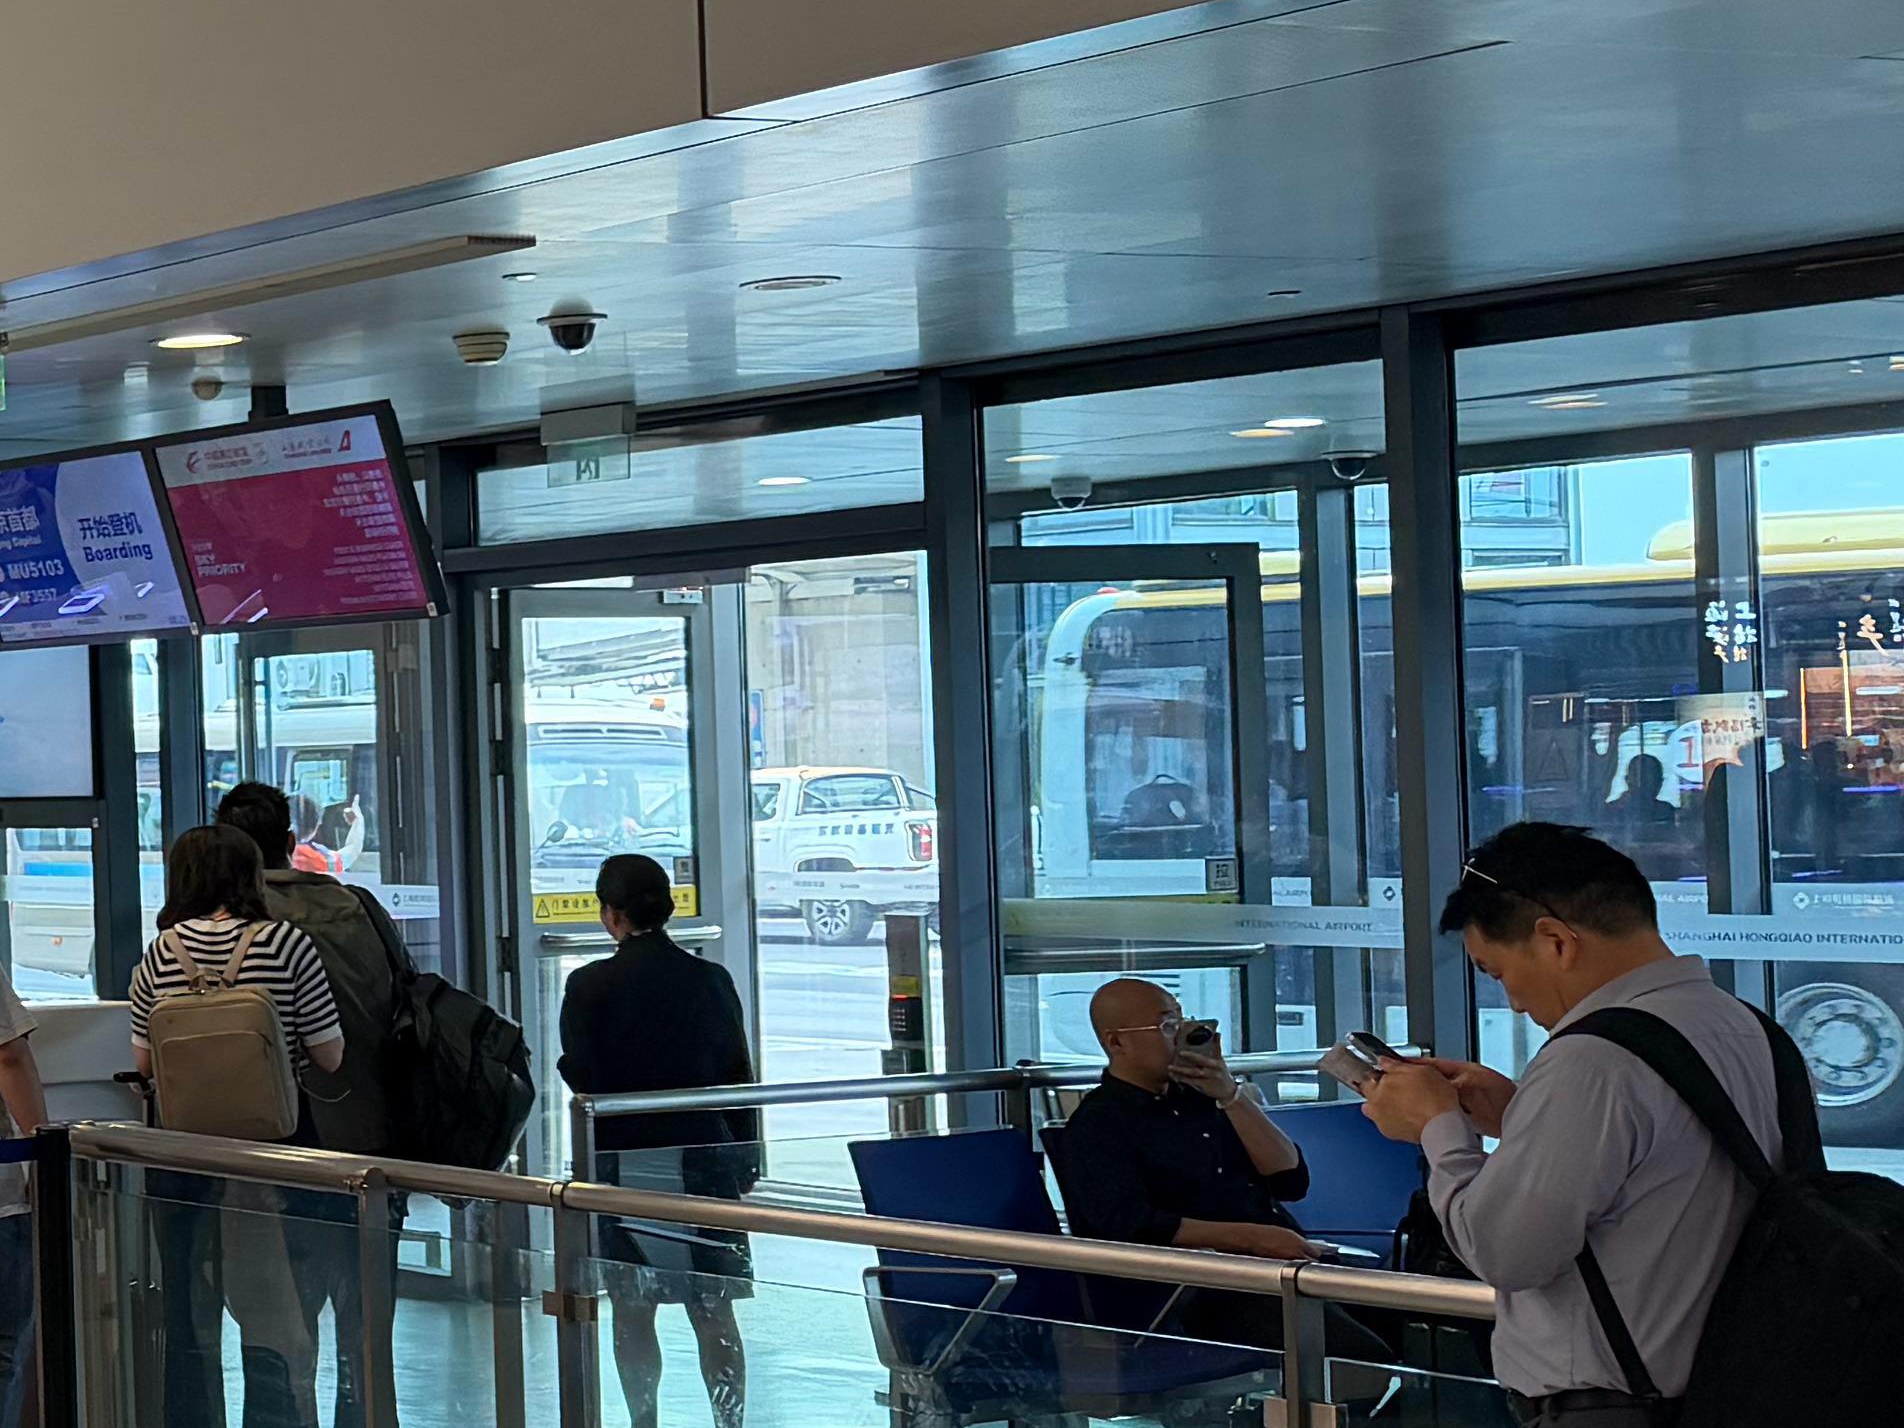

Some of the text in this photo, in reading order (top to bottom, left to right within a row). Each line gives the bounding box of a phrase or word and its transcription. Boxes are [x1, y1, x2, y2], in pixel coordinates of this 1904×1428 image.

[78, 511, 143, 540] 开始登机
[83, 542, 154, 563] Boarding
[7, 558, 65, 580] MU5103
[1740, 932, 1813, 945] HONGQIAO
